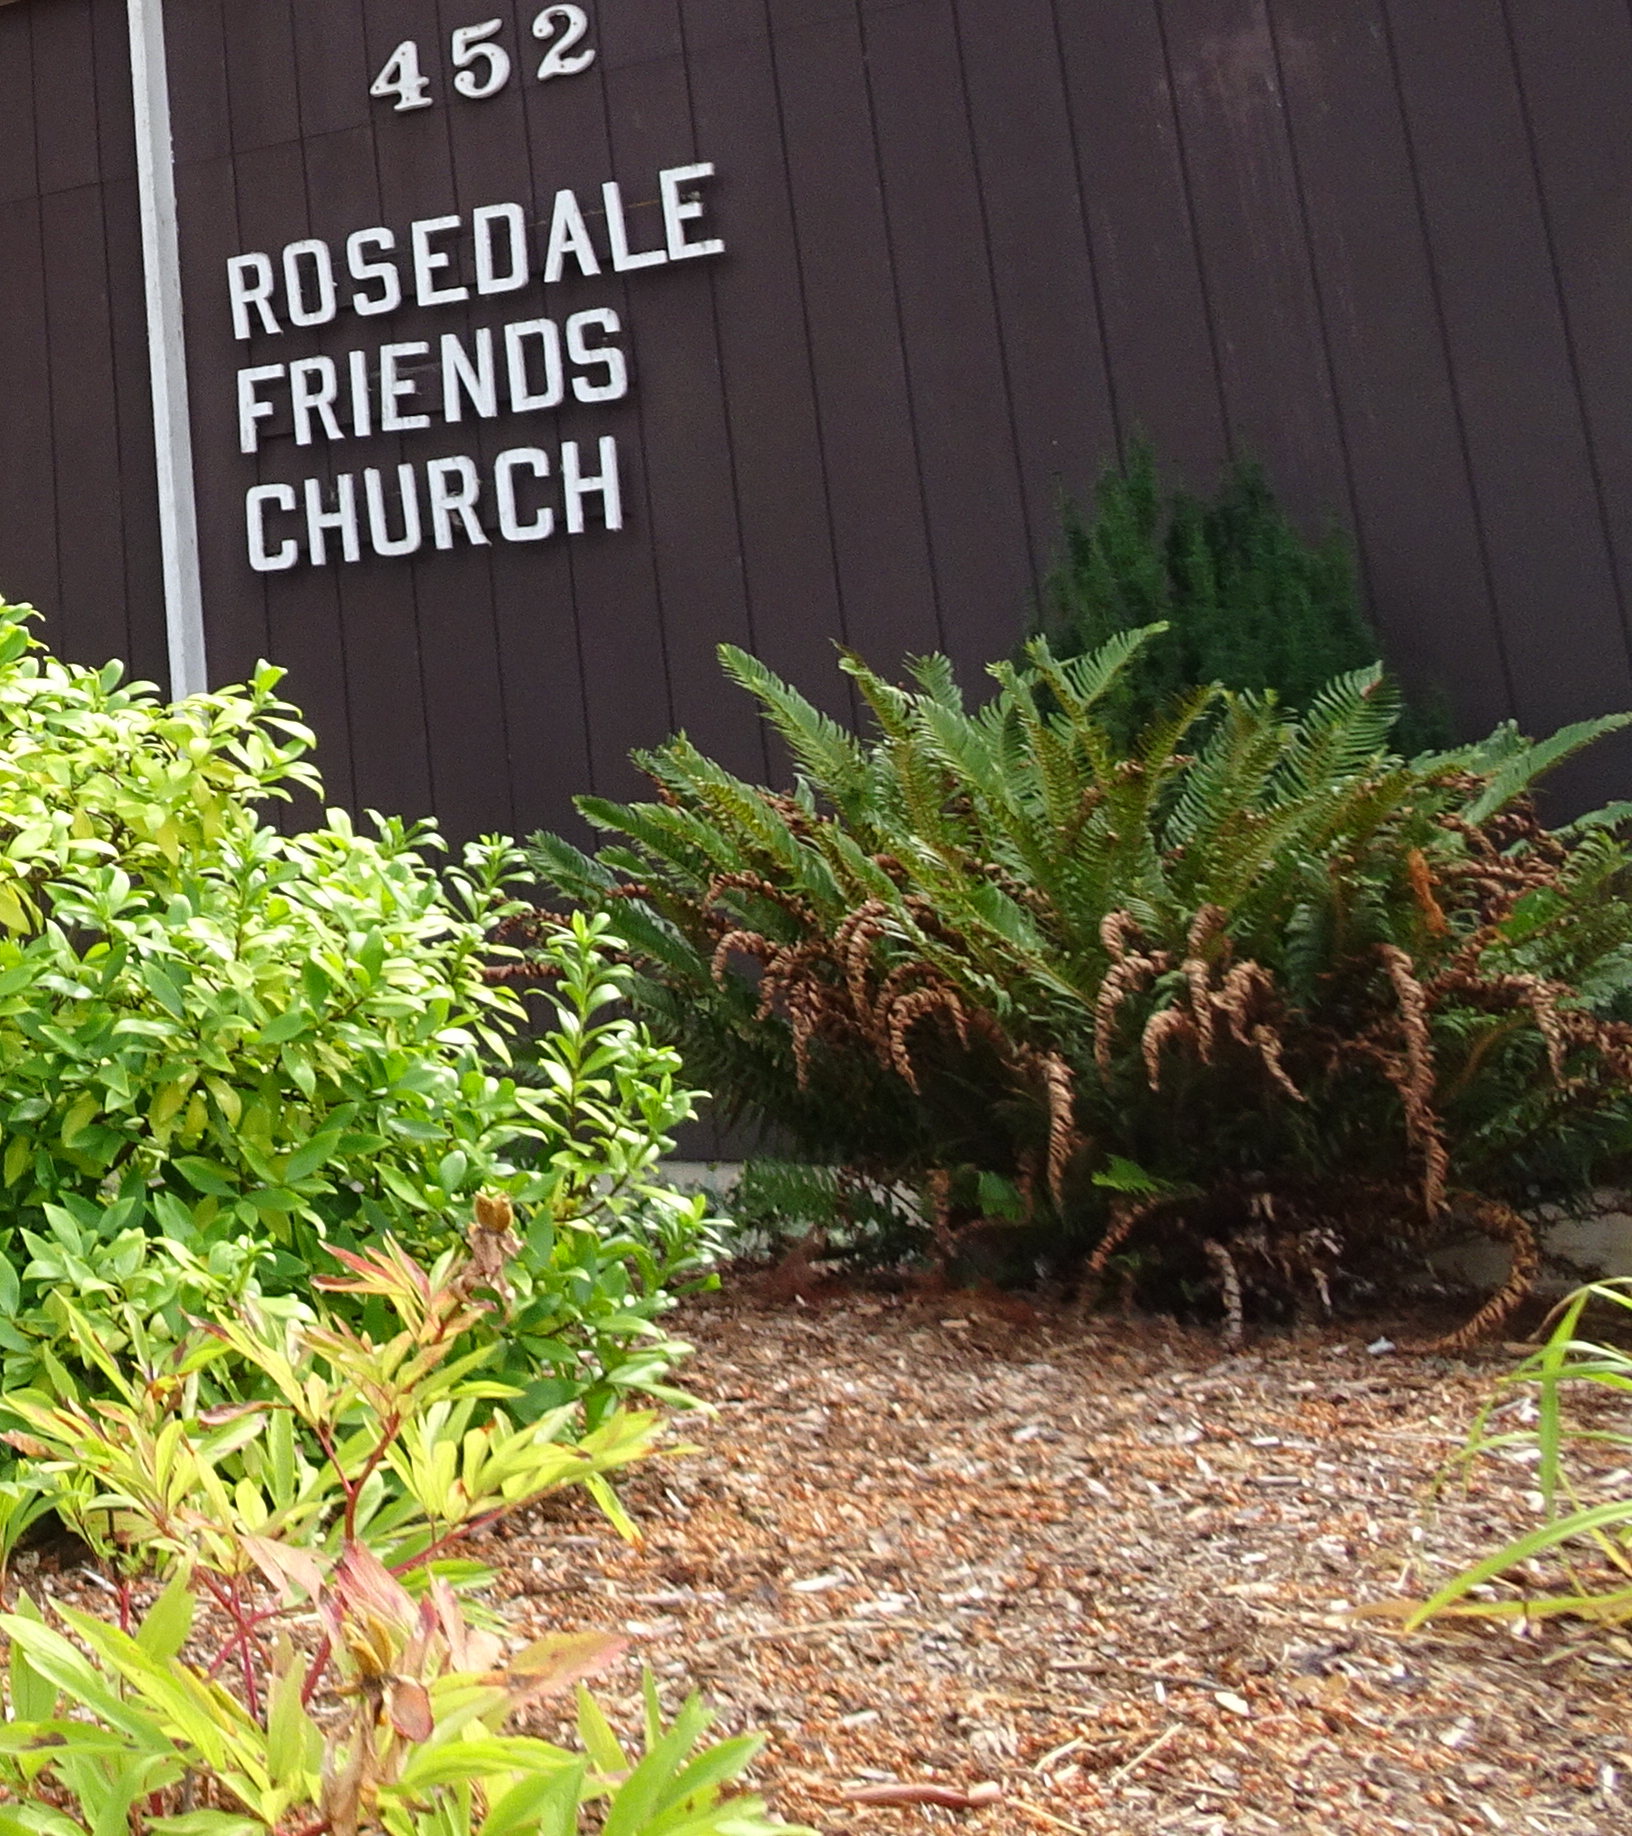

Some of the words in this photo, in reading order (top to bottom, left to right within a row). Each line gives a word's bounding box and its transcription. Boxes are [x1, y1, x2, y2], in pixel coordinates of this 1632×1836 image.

[369, 3, 597, 111] 452
[226, 162, 725, 340] ROSEDALE
[237, 307, 629, 454] FRIENDS
[245, 435, 623, 572] CHURCH
